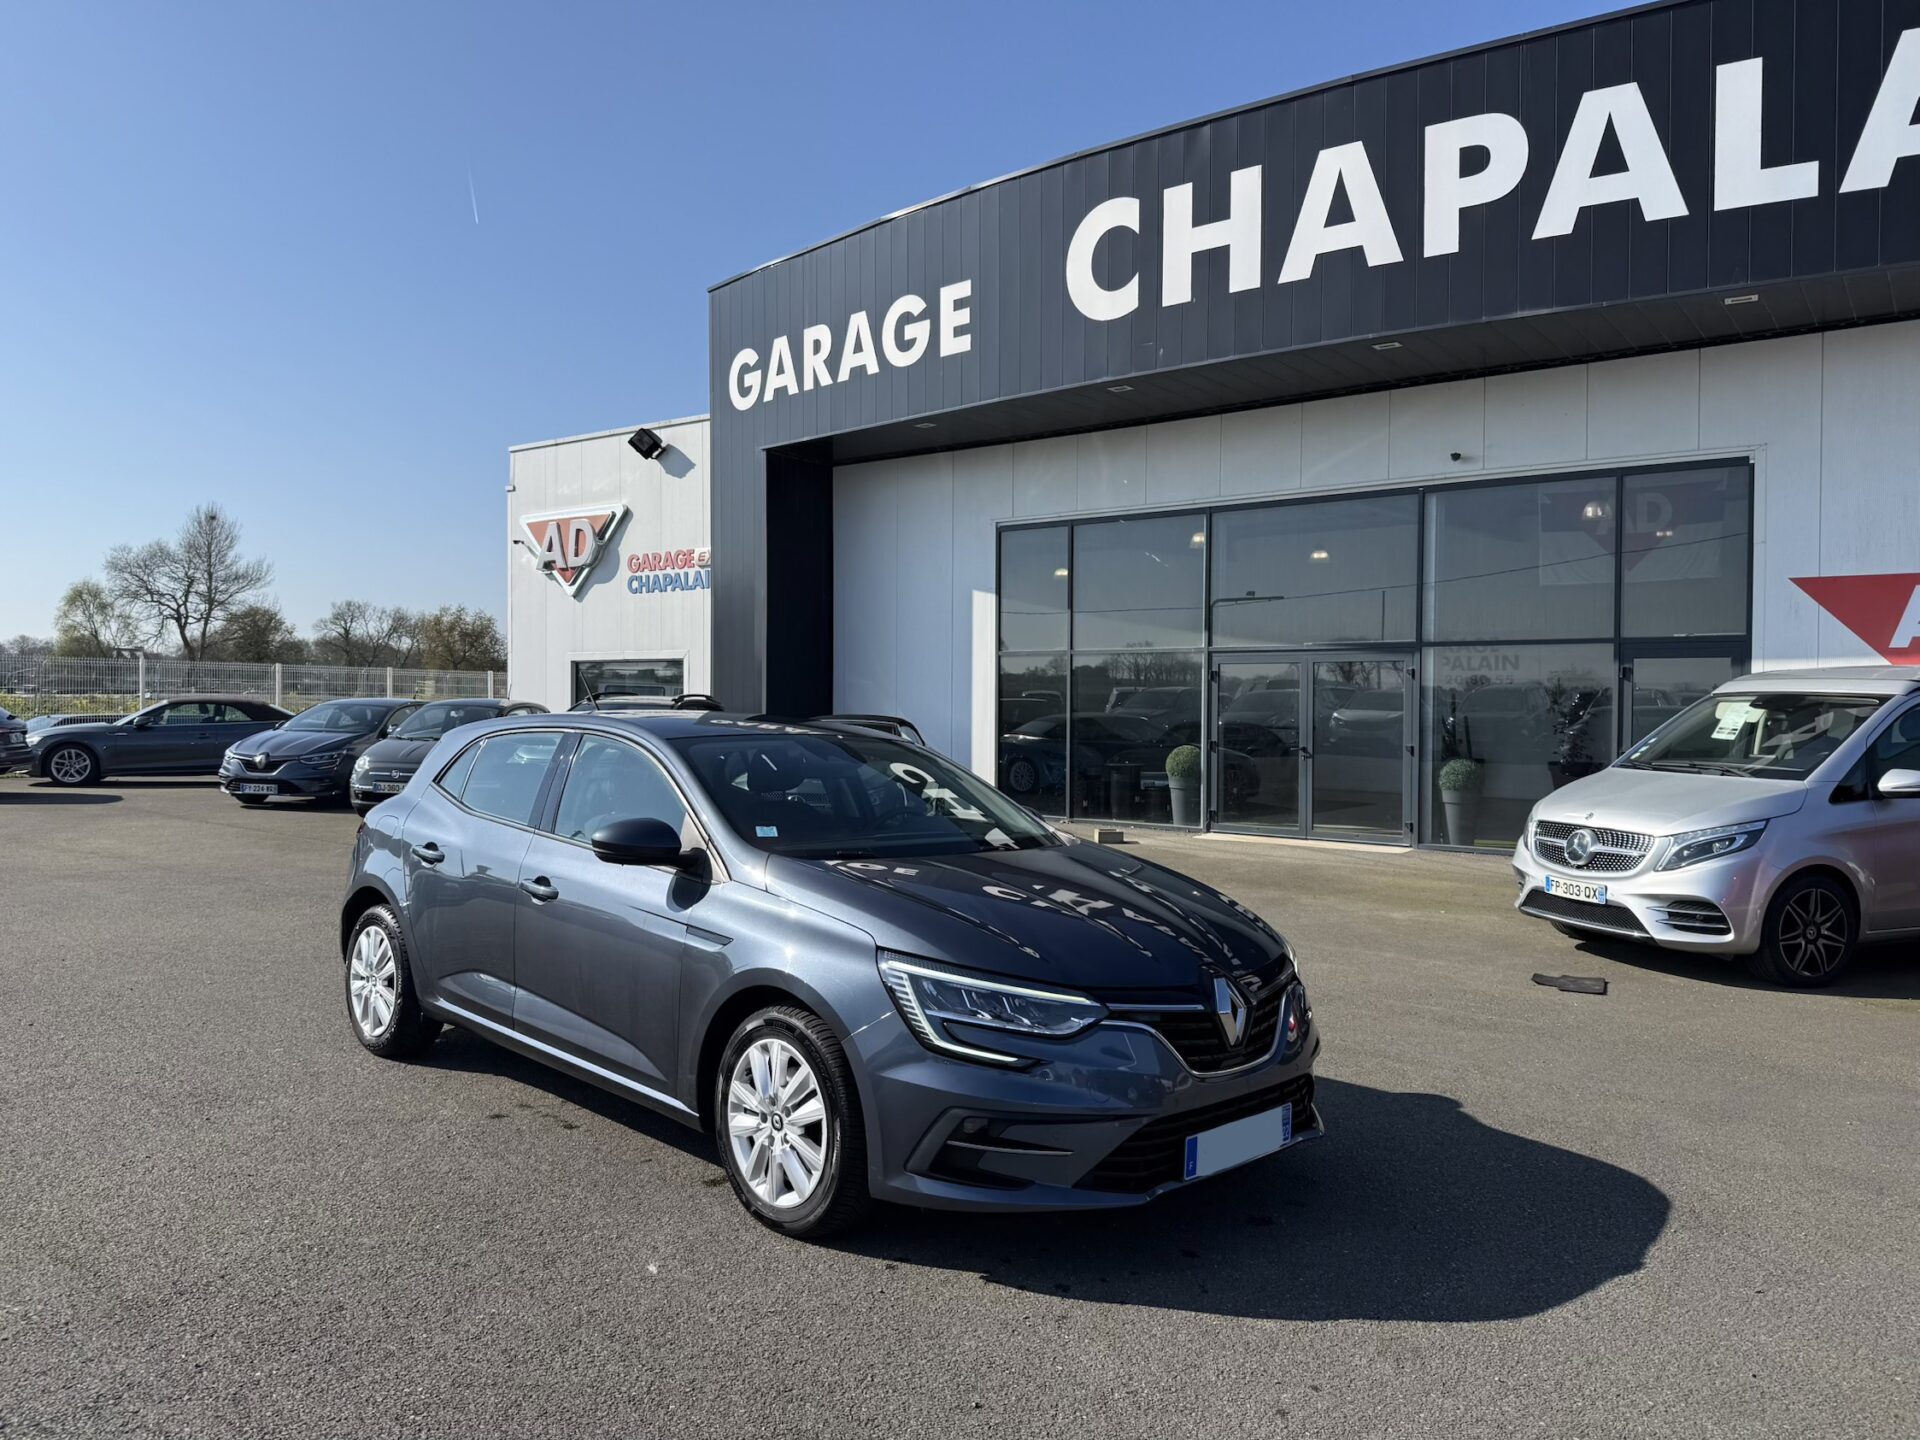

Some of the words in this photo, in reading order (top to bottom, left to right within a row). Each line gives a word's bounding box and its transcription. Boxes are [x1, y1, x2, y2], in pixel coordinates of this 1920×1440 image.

[729, 279, 972, 411] GARAGE
[536, 518, 597, 570] AD
[627, 548, 695, 573] GARAGE
[1550, 879, 1598, 900] FP-303-QX
